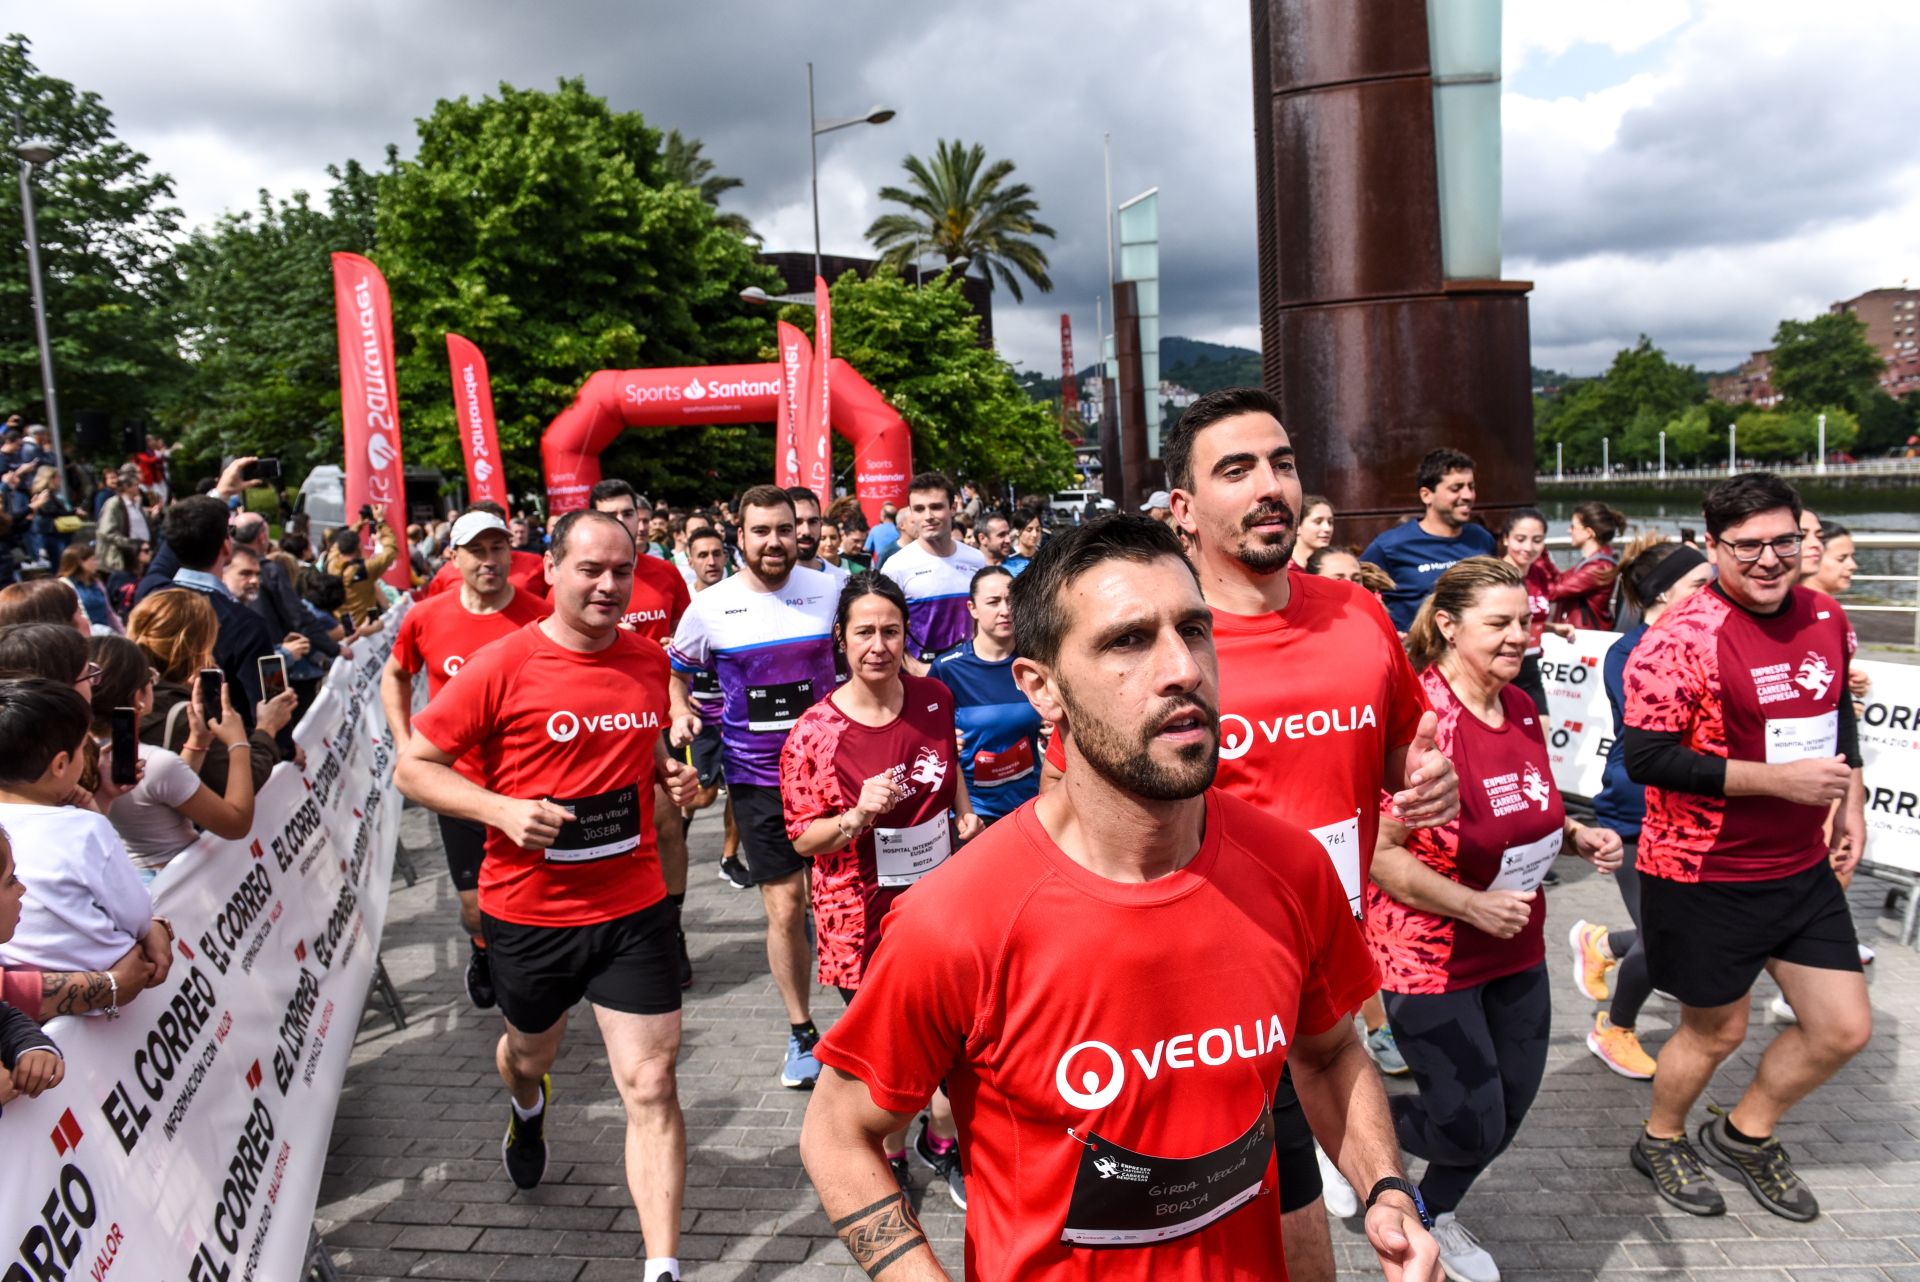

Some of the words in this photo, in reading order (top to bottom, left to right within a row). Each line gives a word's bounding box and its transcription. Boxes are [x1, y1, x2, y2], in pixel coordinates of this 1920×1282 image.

[625, 383, 681, 405] Sports
[708, 378, 781, 399] Santand
[866, 459, 893, 470] Sports
[620, 609, 666, 624] VEOLIA
[1541, 661, 1587, 685] REO
[583, 712, 659, 733] VEOLIA
[1258, 705, 1377, 743] VEOLIA
[271, 836, 293, 873] EL
[1327, 832, 1346, 845] 761
[200, 931, 231, 976] EL
[217, 862, 272, 951] CORREO
[313, 932, 333, 969] EL
[279, 967, 319, 1061] CORREO
[101, 1080, 152, 1157] EL
[134, 966, 216, 1102] CORREO
[273, 1044, 295, 1097] EL
[1131, 1014, 1287, 1080] VEOLIA
[162, 1063, 206, 1142] INFORMACIÓN
[203, 1039, 219, 1068] CON
[214, 1010, 234, 1045] VALOR
[215, 1097, 275, 1255] CORREO
[267, 1140, 291, 1205] BALIOTSUA
[0, 1163, 96, 1282] REO
[90, 1222, 125, 1282] VALOR
